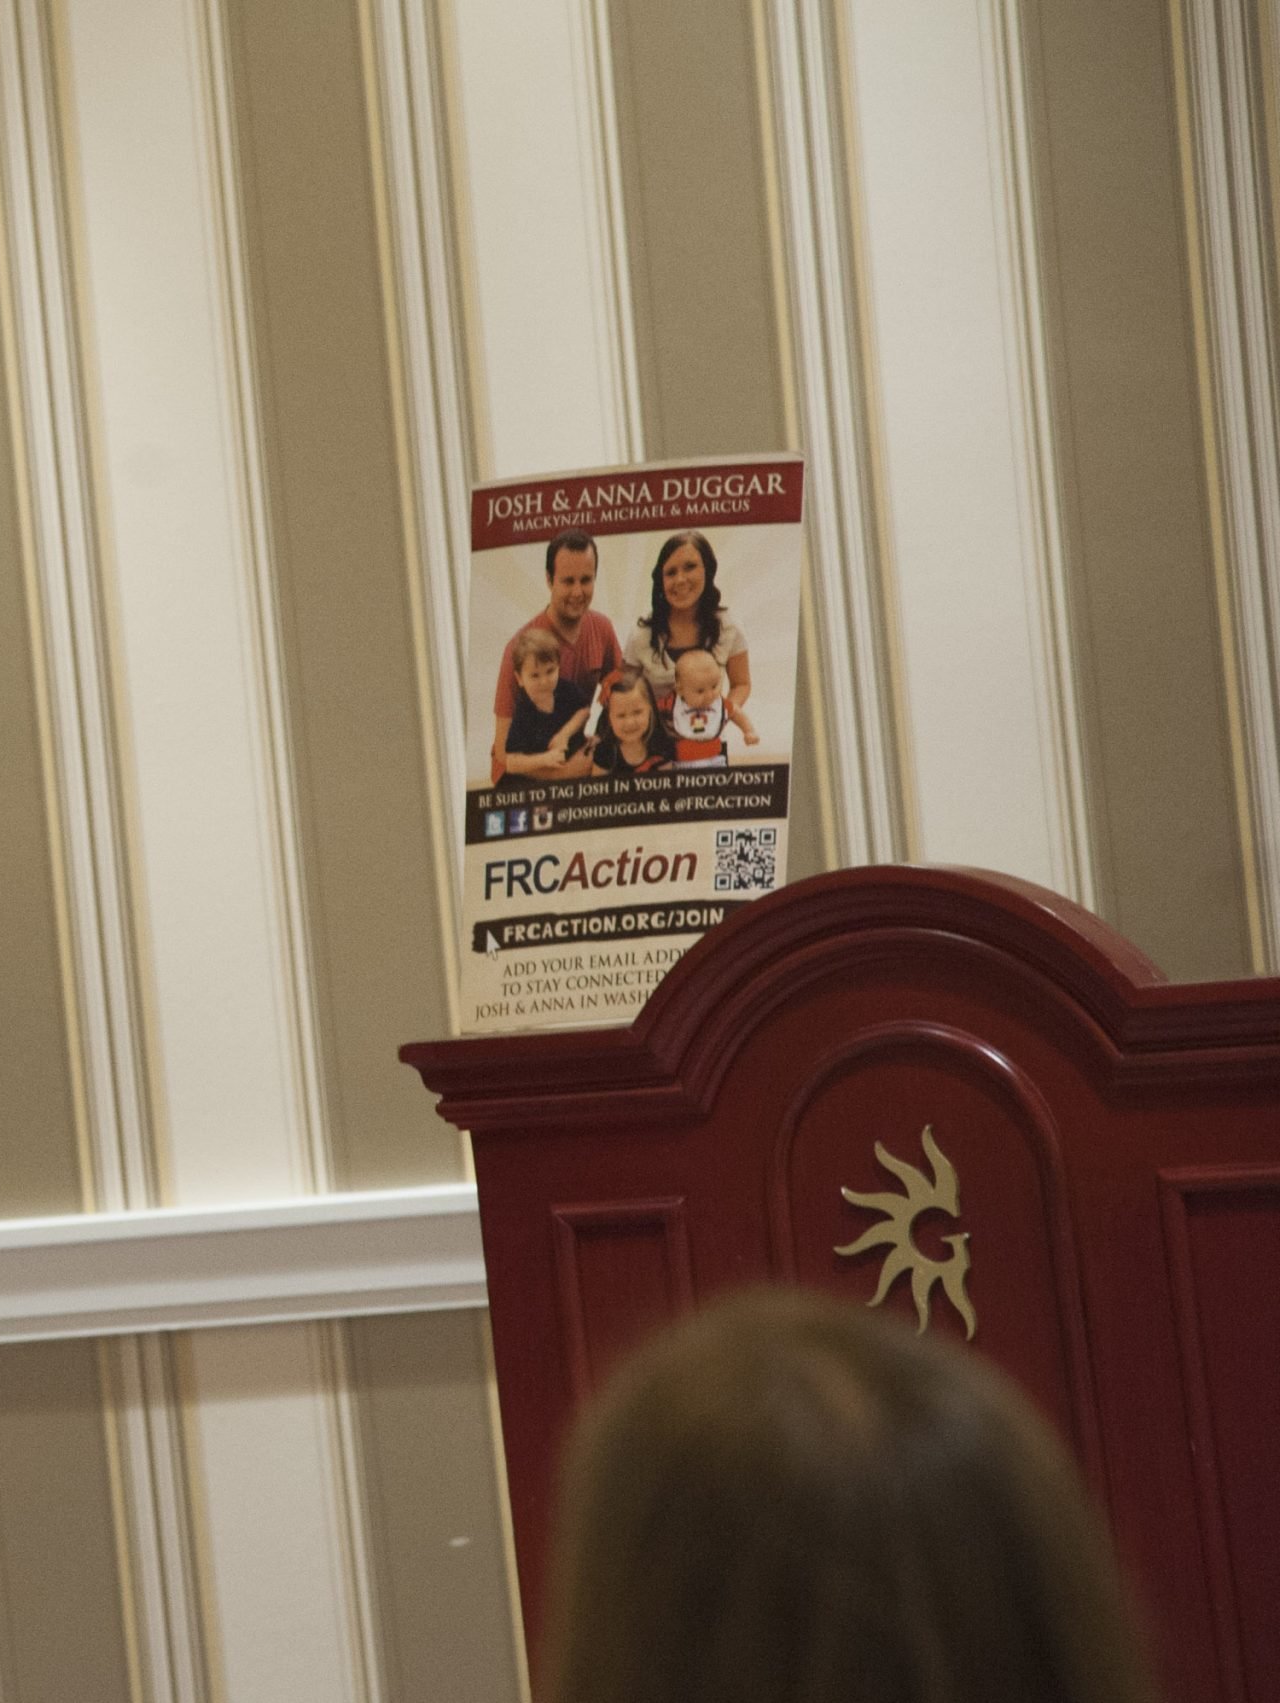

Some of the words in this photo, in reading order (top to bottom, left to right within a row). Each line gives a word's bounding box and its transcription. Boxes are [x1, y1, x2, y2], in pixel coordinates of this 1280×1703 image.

[487, 491, 543, 527] JOSH
[551, 488, 571, 512] &
[577, 481, 653, 509] ANNA
[662, 472, 786, 501] DUGGAR
[600, 504, 666, 523] MICHAEL
[670, 503, 682, 516] &
[686, 499, 751, 516] MARCUS
[479, 795, 492, 809] BE
[495, 790, 526, 806] SURE
[529, 788, 546, 802] TO
[549, 783, 574, 800] TAG
[578, 780, 609, 799] JOSH
[614, 779, 630, 794] IN
[634, 776, 672, 792] YOUR
[676, 769, 775, 788] PHOTO/POST!
[557, 802, 656, 824] @JOSHDUGGAR
[659, 799, 670, 813] &
[674, 793, 772, 813] @FRCACTION
[484, 846, 699, 901] FRCAction
[503, 960, 538, 979] ADD
[541, 955, 584, 974] YOUR
[589, 951, 640, 970] EMAIL
[501, 981, 522, 998] TO
[526, 978, 562, 995] STAY
[565, 969, 669, 991] CONNECTED
[474, 1001, 510, 1022] JOSH
[515, 1000, 526, 1015] &
[530, 996, 575, 1014] ANNA
[580, 993, 599, 1009] IN
